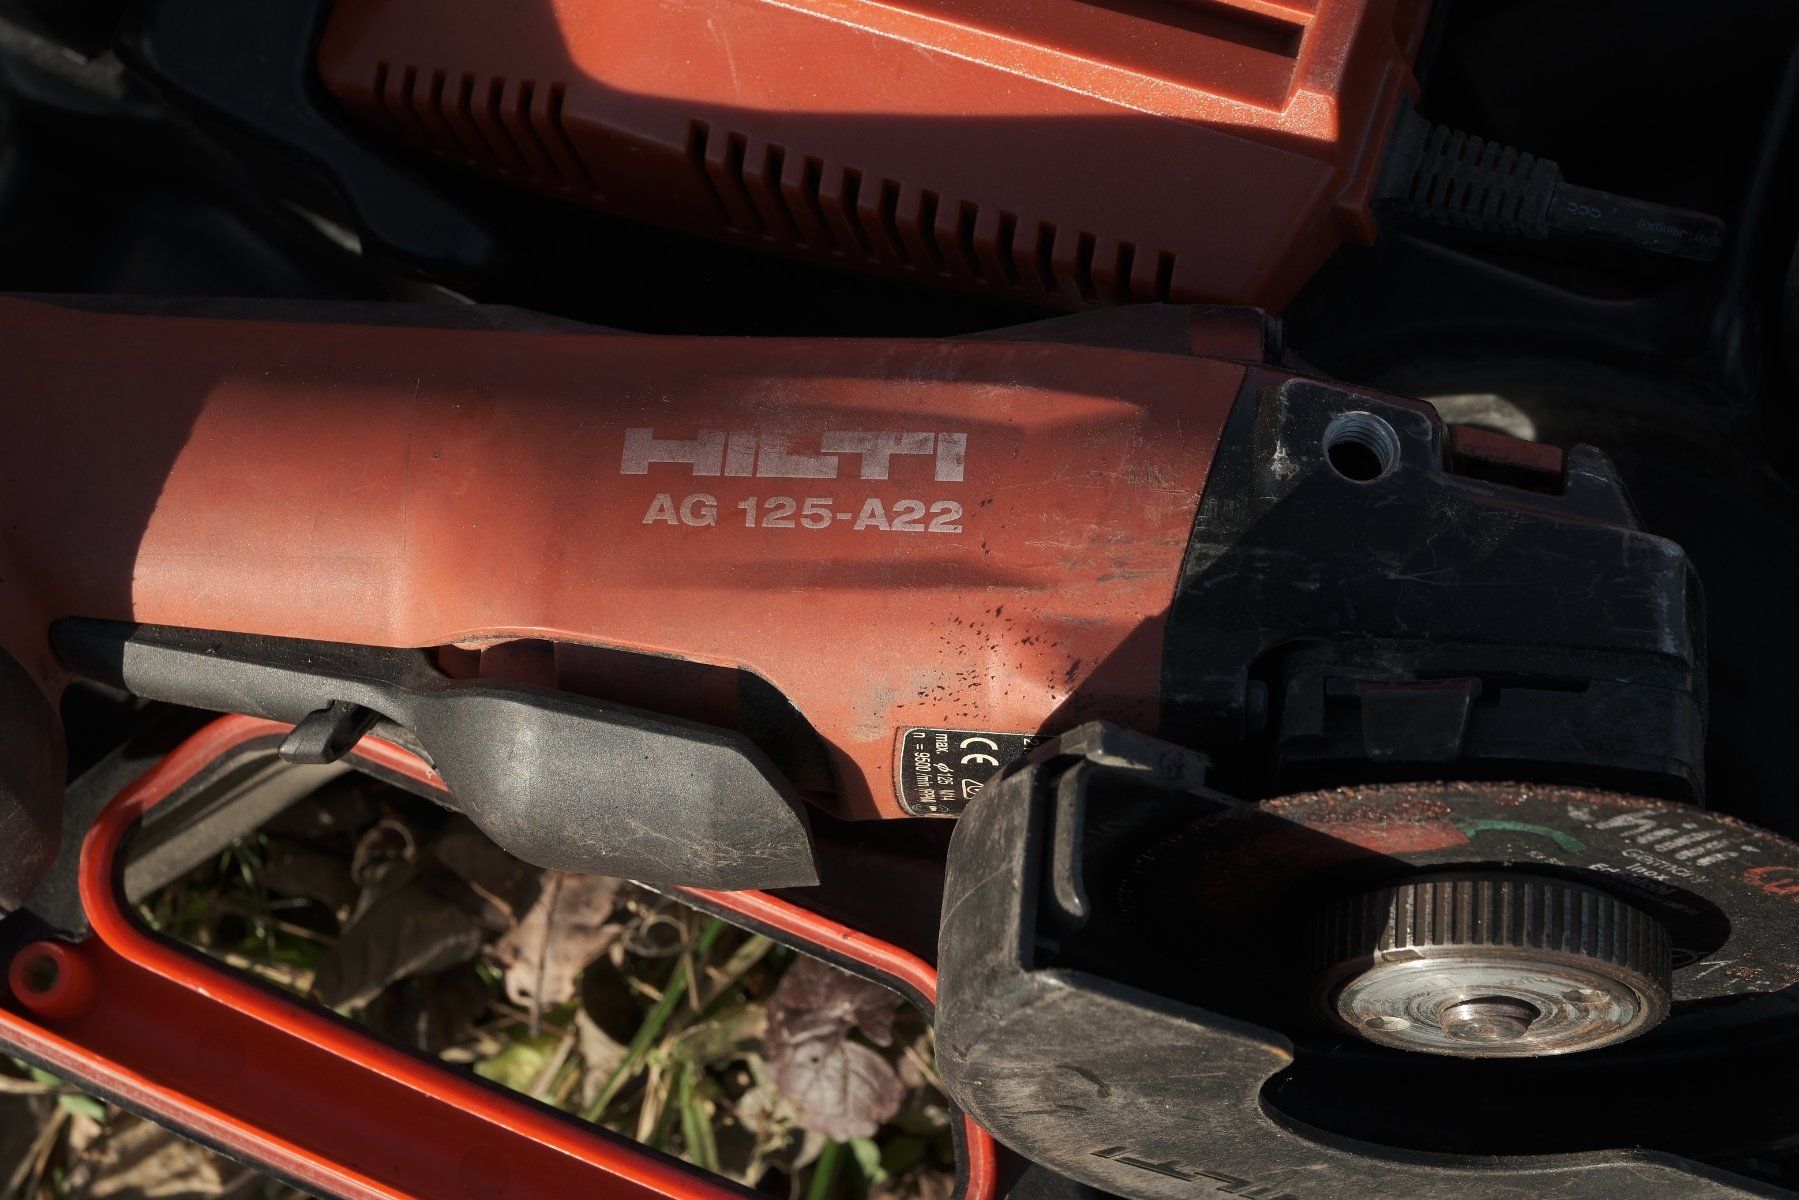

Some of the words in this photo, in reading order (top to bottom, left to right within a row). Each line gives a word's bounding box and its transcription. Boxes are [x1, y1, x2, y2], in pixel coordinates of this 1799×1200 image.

[619, 426, 968, 482] HILTI
[641, 492, 718, 528] AG
[737, 494, 963, 534] 125-A22
[935, 732, 950, 755] max.
[960, 737, 998, 766] CE
[914, 752, 932, 772] 9500
[1625, 861, 1672, 882] Inox
